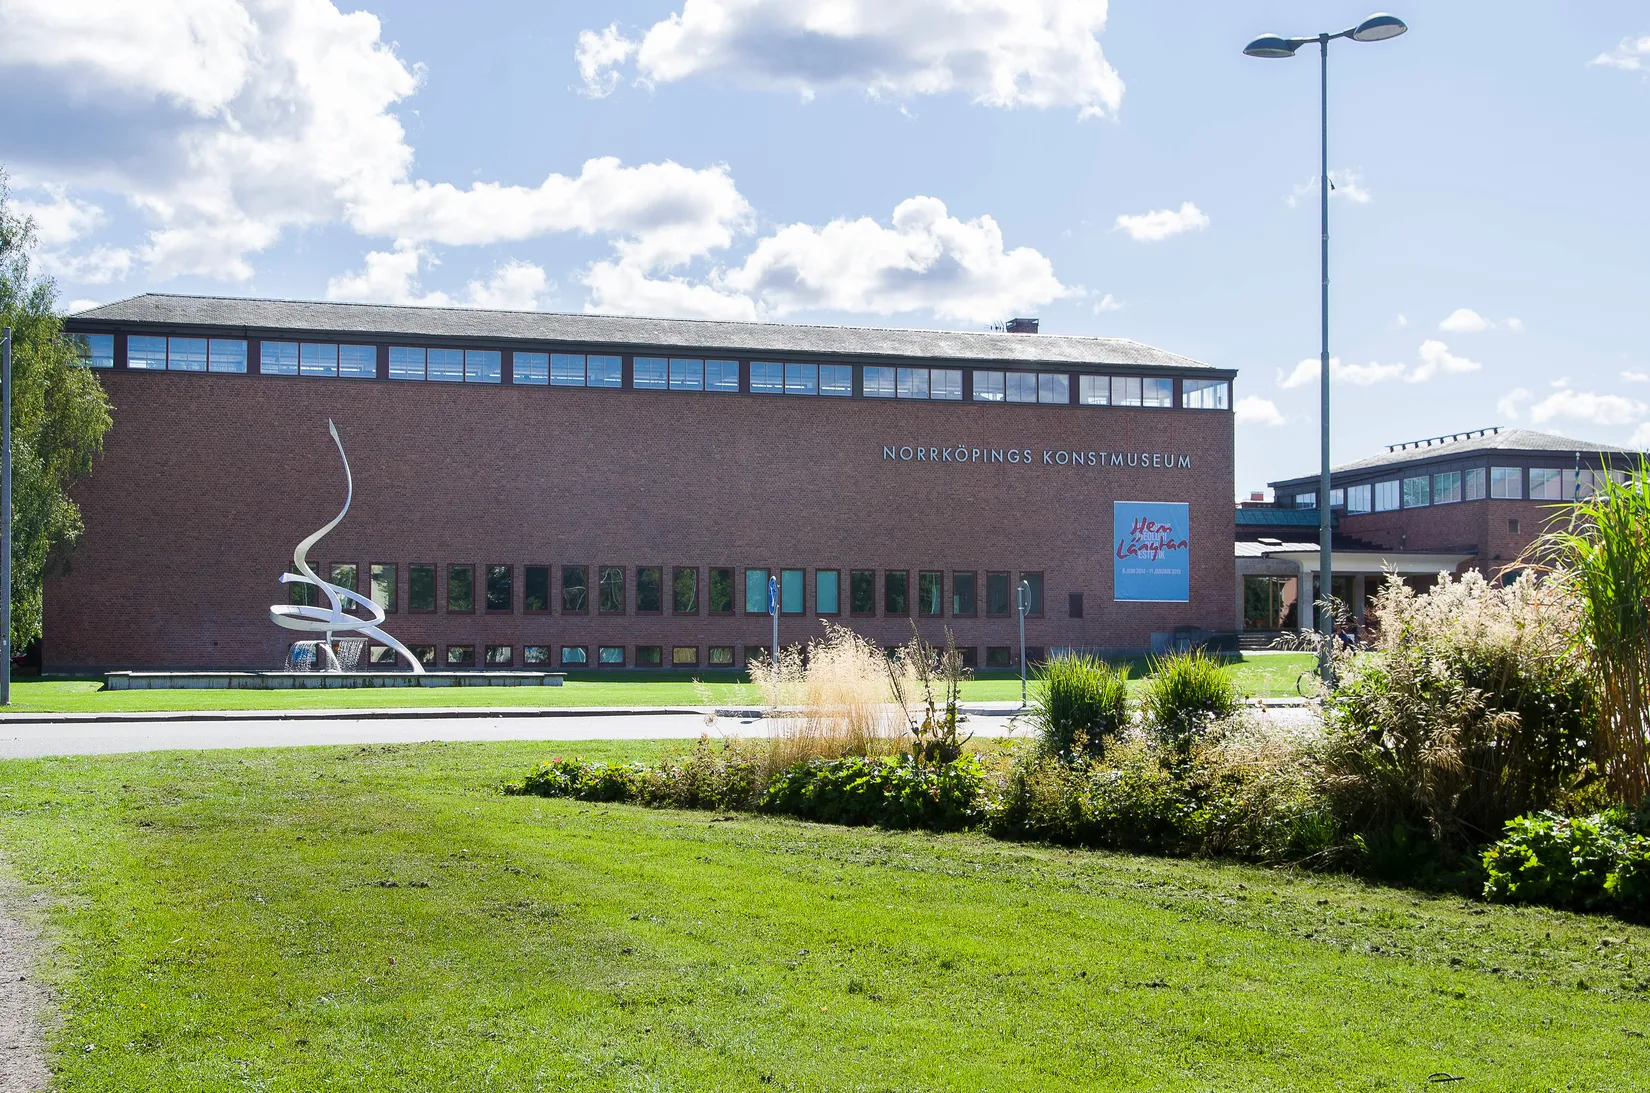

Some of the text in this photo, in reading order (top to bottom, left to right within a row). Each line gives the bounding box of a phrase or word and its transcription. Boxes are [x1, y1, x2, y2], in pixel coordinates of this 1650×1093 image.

[883, 445, 1192, 469] NORRKÖPINGS KONSTMUSEUM
[1130, 516, 1172, 535] Hem
[1116, 536, 1188, 561] Längtan
